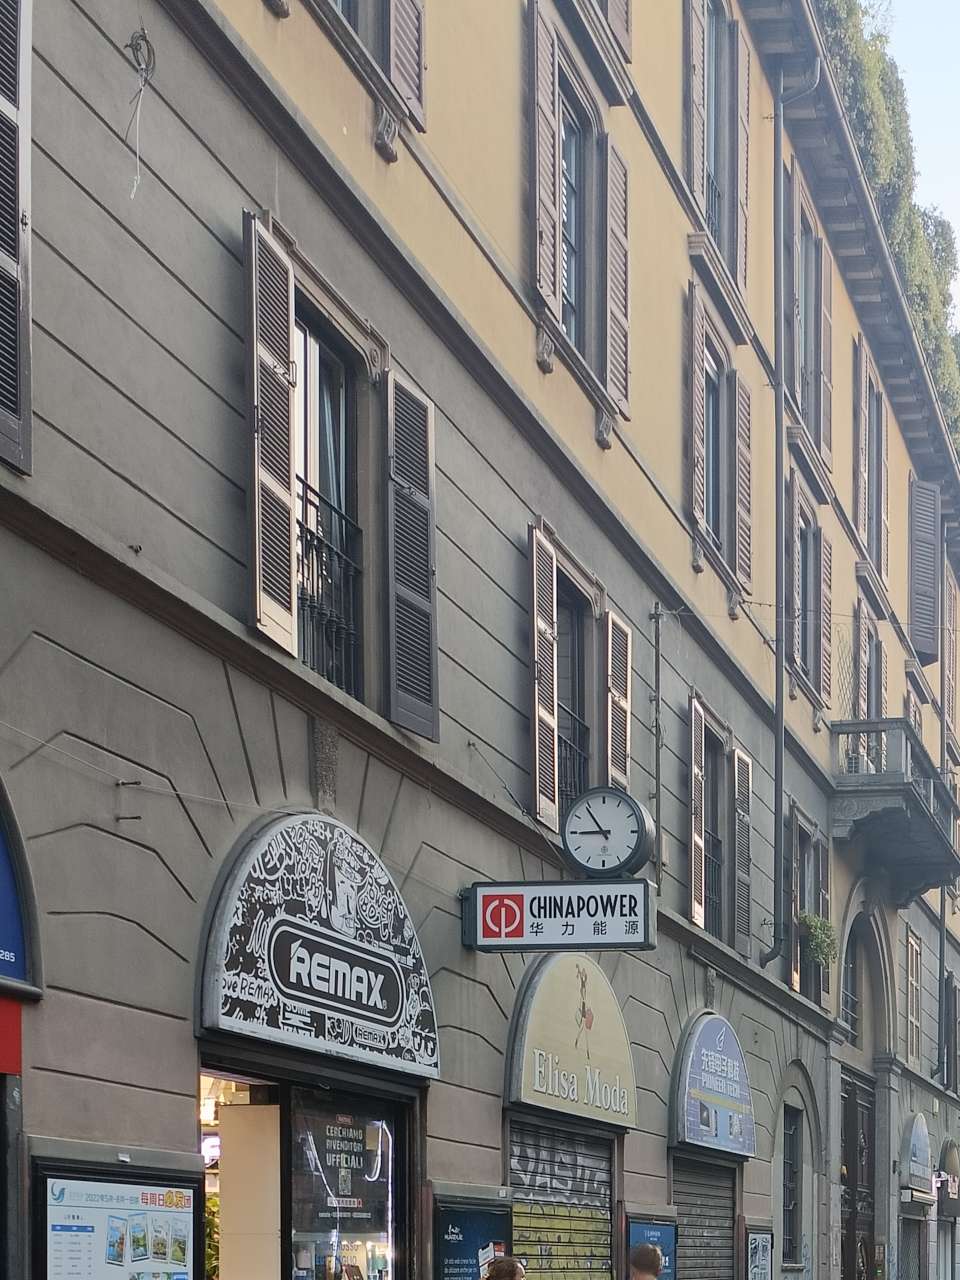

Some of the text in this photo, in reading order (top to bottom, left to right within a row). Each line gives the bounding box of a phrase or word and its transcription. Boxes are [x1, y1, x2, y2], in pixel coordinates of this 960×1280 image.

[529, 894, 639, 919] CHINAPOWER
[529, 920, 639, 937] 华力能源
[289, 939, 385, 1010] REMAX
[356, 1027, 386, 1046] REMAX
[532, 1047, 630, 1116] Elisa Moda
[326, 1124, 363, 1140] CERCHIAMO
[326, 1138, 363, 1152] RIVENDITORI
[326, 1153, 364, 1169] UFFICIALI
